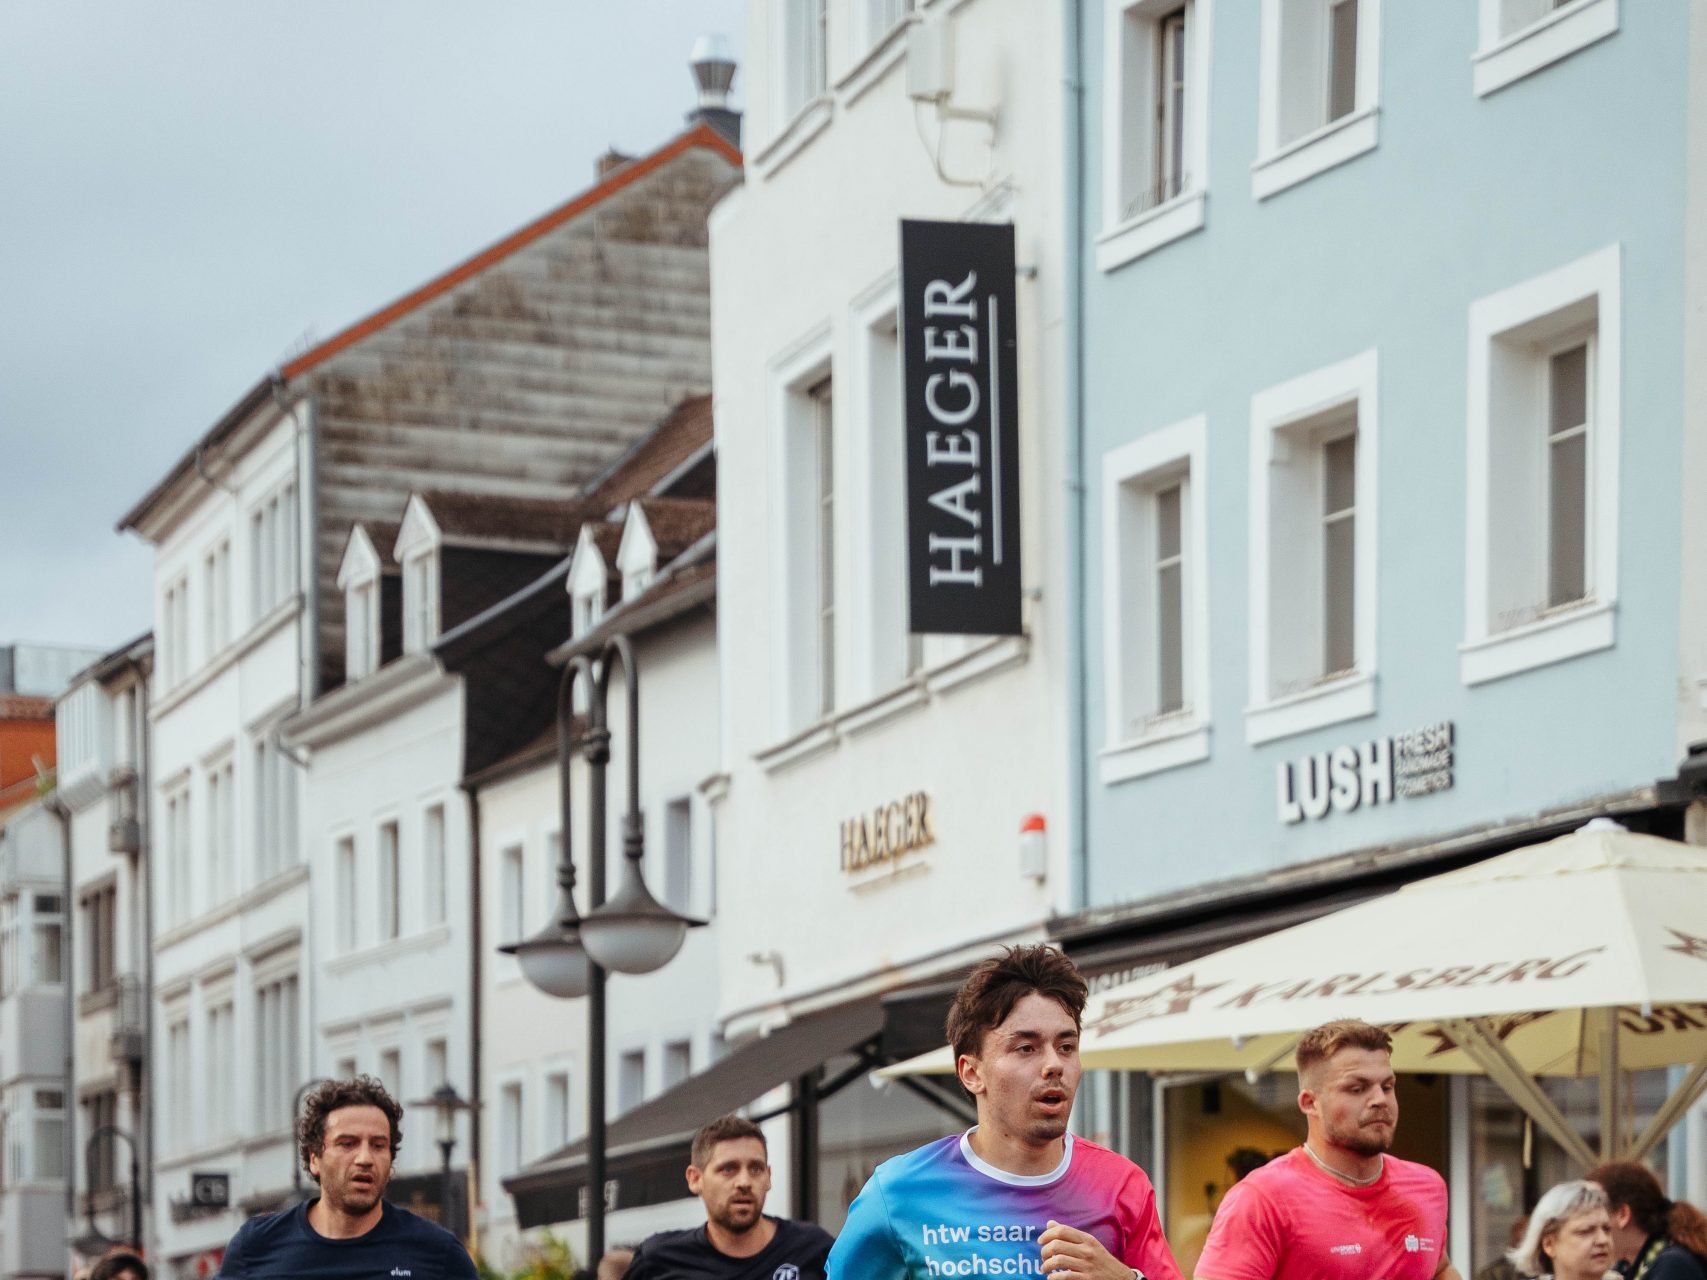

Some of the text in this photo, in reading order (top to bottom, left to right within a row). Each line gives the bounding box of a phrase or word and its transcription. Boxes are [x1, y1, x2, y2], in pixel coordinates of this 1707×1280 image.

[924, 269, 983, 587] HAEGER
[1278, 736, 1393, 824] LUSH
[840, 789, 935, 873] HAEGER
[1213, 944, 1606, 1010] KARLSBERG
[922, 1224, 1036, 1245] htw saar
[924, 1253, 1072, 1277] hochschu
